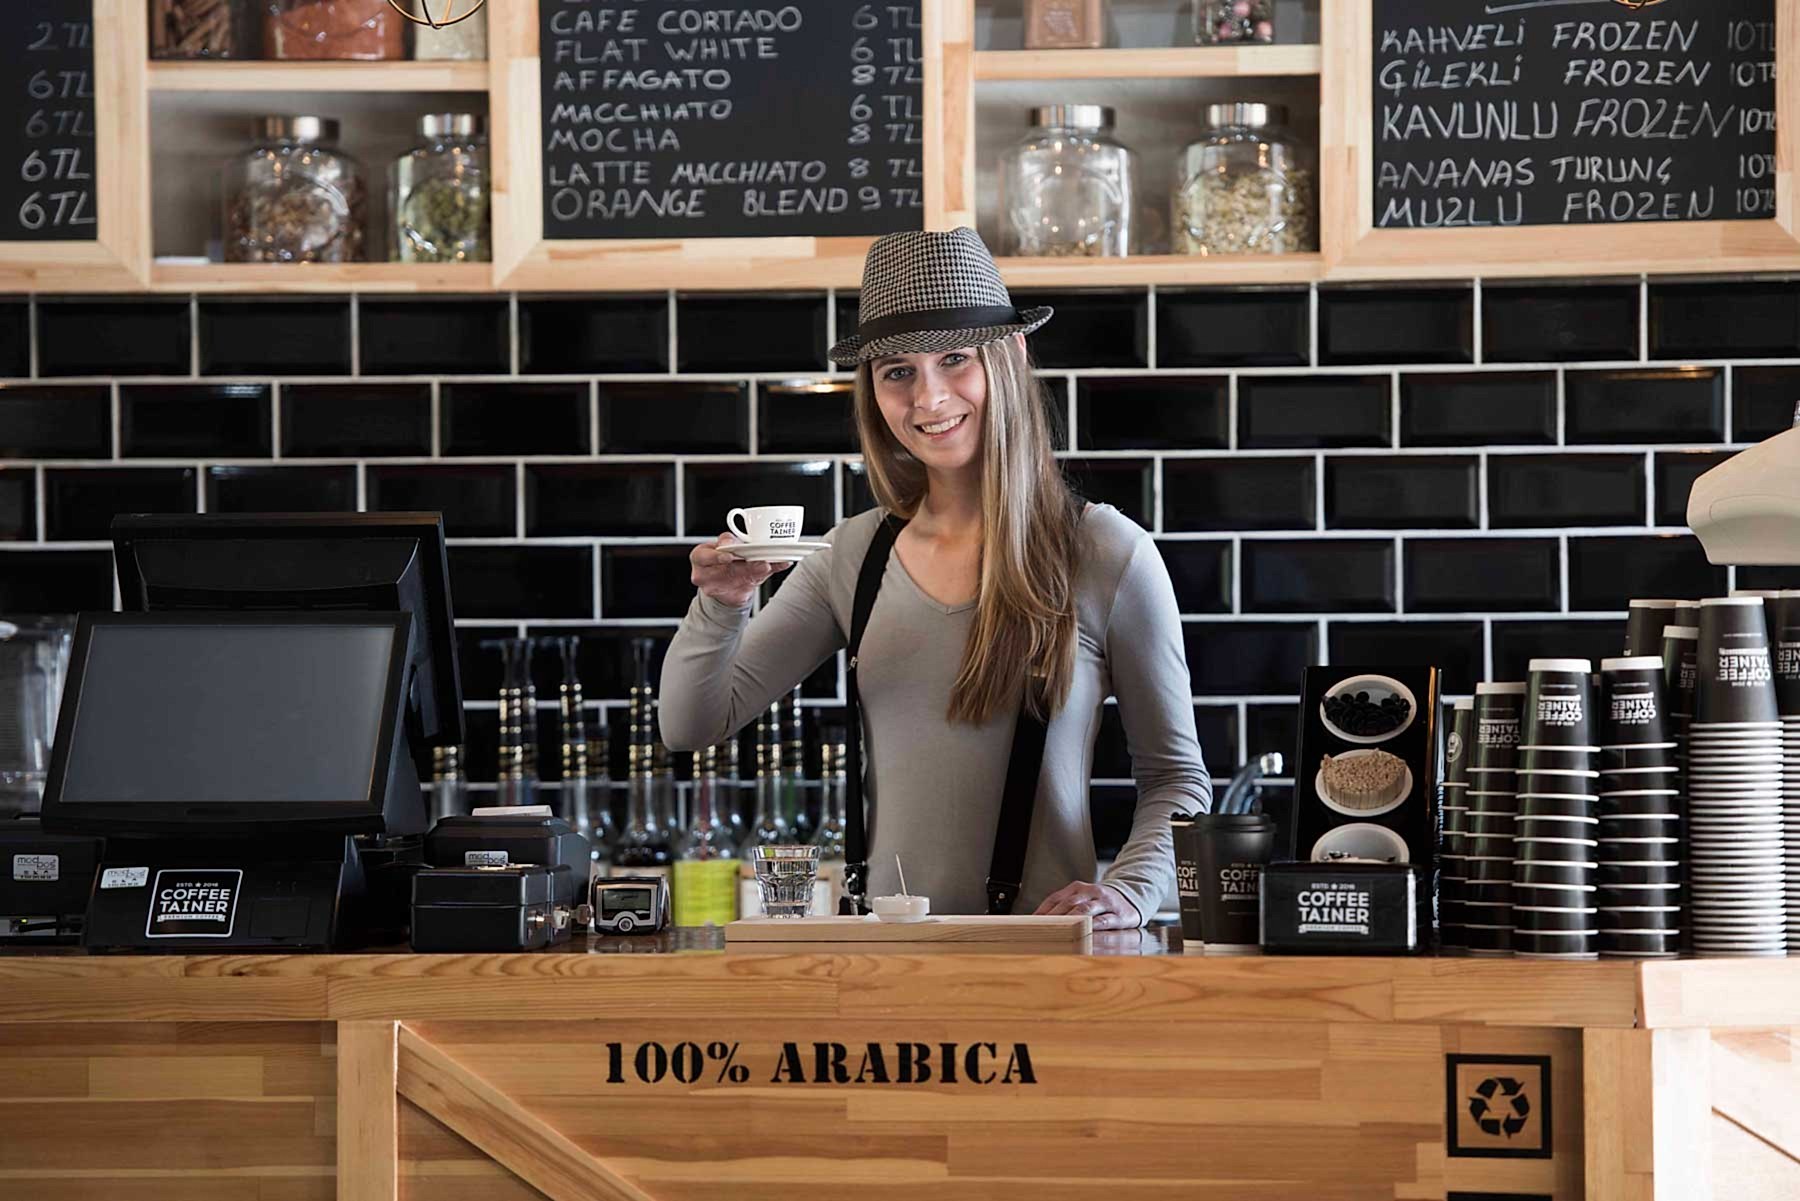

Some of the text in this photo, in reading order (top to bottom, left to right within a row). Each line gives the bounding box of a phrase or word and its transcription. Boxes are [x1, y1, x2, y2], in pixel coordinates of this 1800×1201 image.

[551, 5, 921, 35] CAFE CORTADO 6 TL
[1551, 20, 1698, 53] FROZEN
[553, 37, 922, 64] FLAT WHITE 6 TL
[852, 64, 876, 85] 8
[882, 66, 921, 85] TL
[1563, 60, 1712, 87] FROZEN
[550, 94, 922, 124] MACCHIATO 6 TL
[1382, 99, 1558, 141] KAVUNLU
[1572, 98, 1736, 140] FROZEN
[548, 123, 921, 151] MOCHA 8 TL
[549, 158, 921, 186] LATTE MACCHIATO 8 TL
[1377, 157, 1536, 190] ANANAS
[551, 186, 921, 221] ORANGE BLEND 9 TL
[1562, 186, 1714, 222] FROZEN
[1719, 655, 1769, 668] TAINER
[1719, 668, 1771, 681] COFFEE
[1538, 701, 1581, 711] TAINER
[1611, 699, 1655, 710] TAINER
[1538, 710, 1582, 721] COFFEE
[1610, 709, 1656, 720] COFFEE
[1479, 725, 1519, 734] TAINER
[1478, 734, 1520, 743] COFFEE
[1220, 869, 1258, 881] COFF
[161, 889, 231, 900] COFFEE
[1221, 881, 1259, 893] TAIN
[160, 900, 228, 913] TAINER
[1298, 891, 1369, 907] COFFEE
[1298, 907, 1369, 923] TAINER
[606, 1042, 1038, 1084] 100% ARABICA
